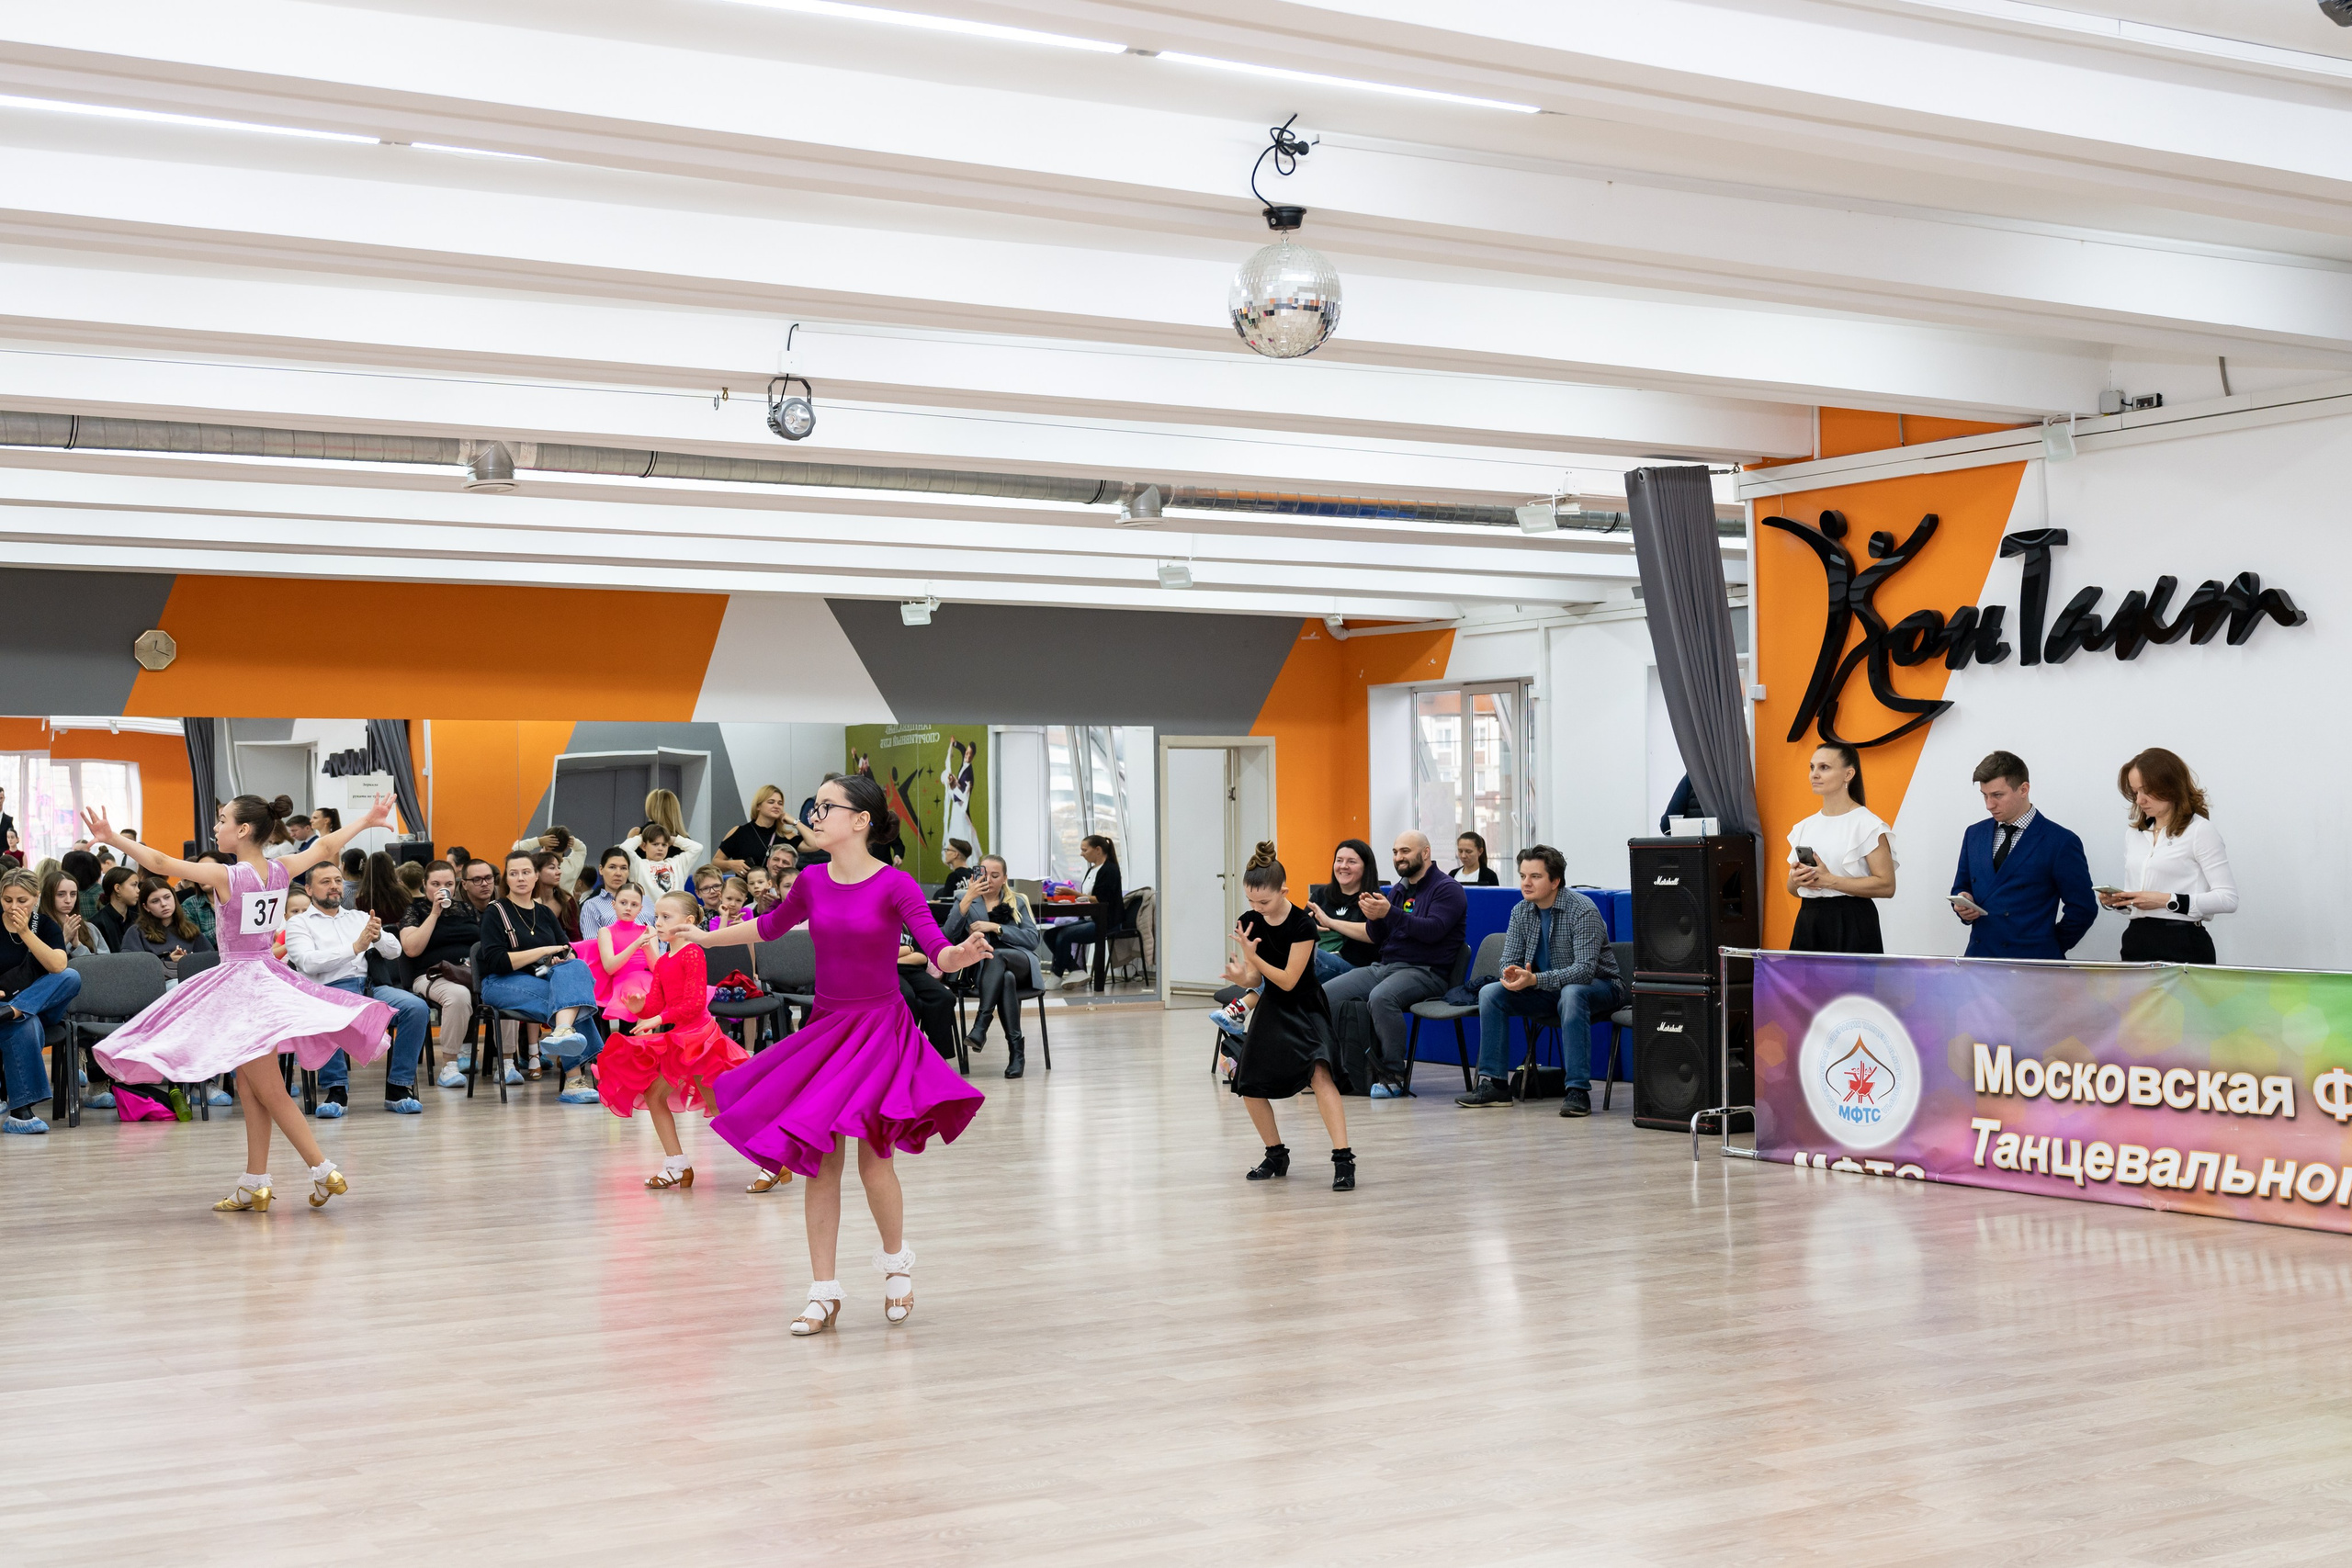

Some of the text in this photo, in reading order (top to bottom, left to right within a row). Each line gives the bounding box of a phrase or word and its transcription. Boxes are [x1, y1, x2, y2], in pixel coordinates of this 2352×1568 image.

[1654, 875, 1679, 886] Marshall
[254, 897, 278, 927] 37
[1657, 1021, 1683, 1032] Marshall
[1973, 1043, 2295, 1118] Московская
[1838, 1105, 1882, 1123] МФТС
